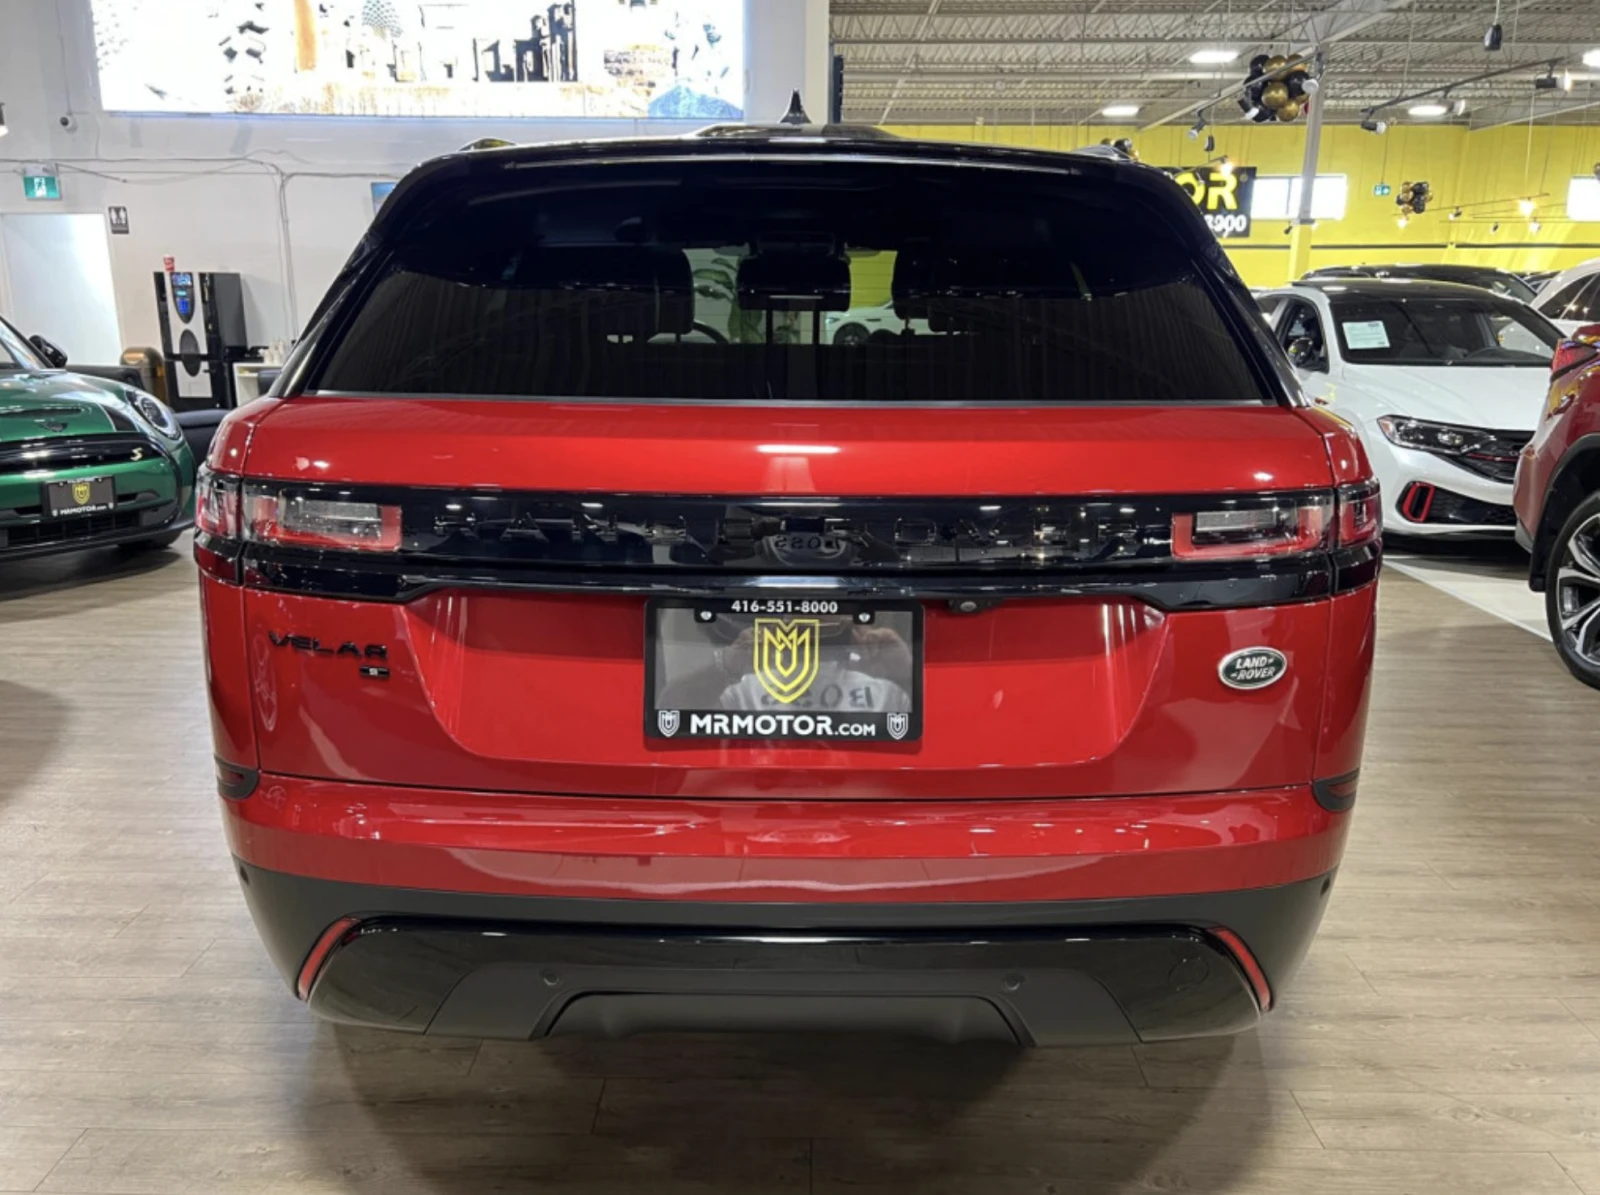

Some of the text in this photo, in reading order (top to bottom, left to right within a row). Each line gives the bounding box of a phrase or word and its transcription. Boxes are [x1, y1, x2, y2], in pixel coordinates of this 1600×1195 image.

[731, 600, 838, 614] 416-551-8000
[268, 630, 388, 660] VELAR
[1235, 655, 1268, 669] LAND
[1236, 665, 1276, 680] ROVER
